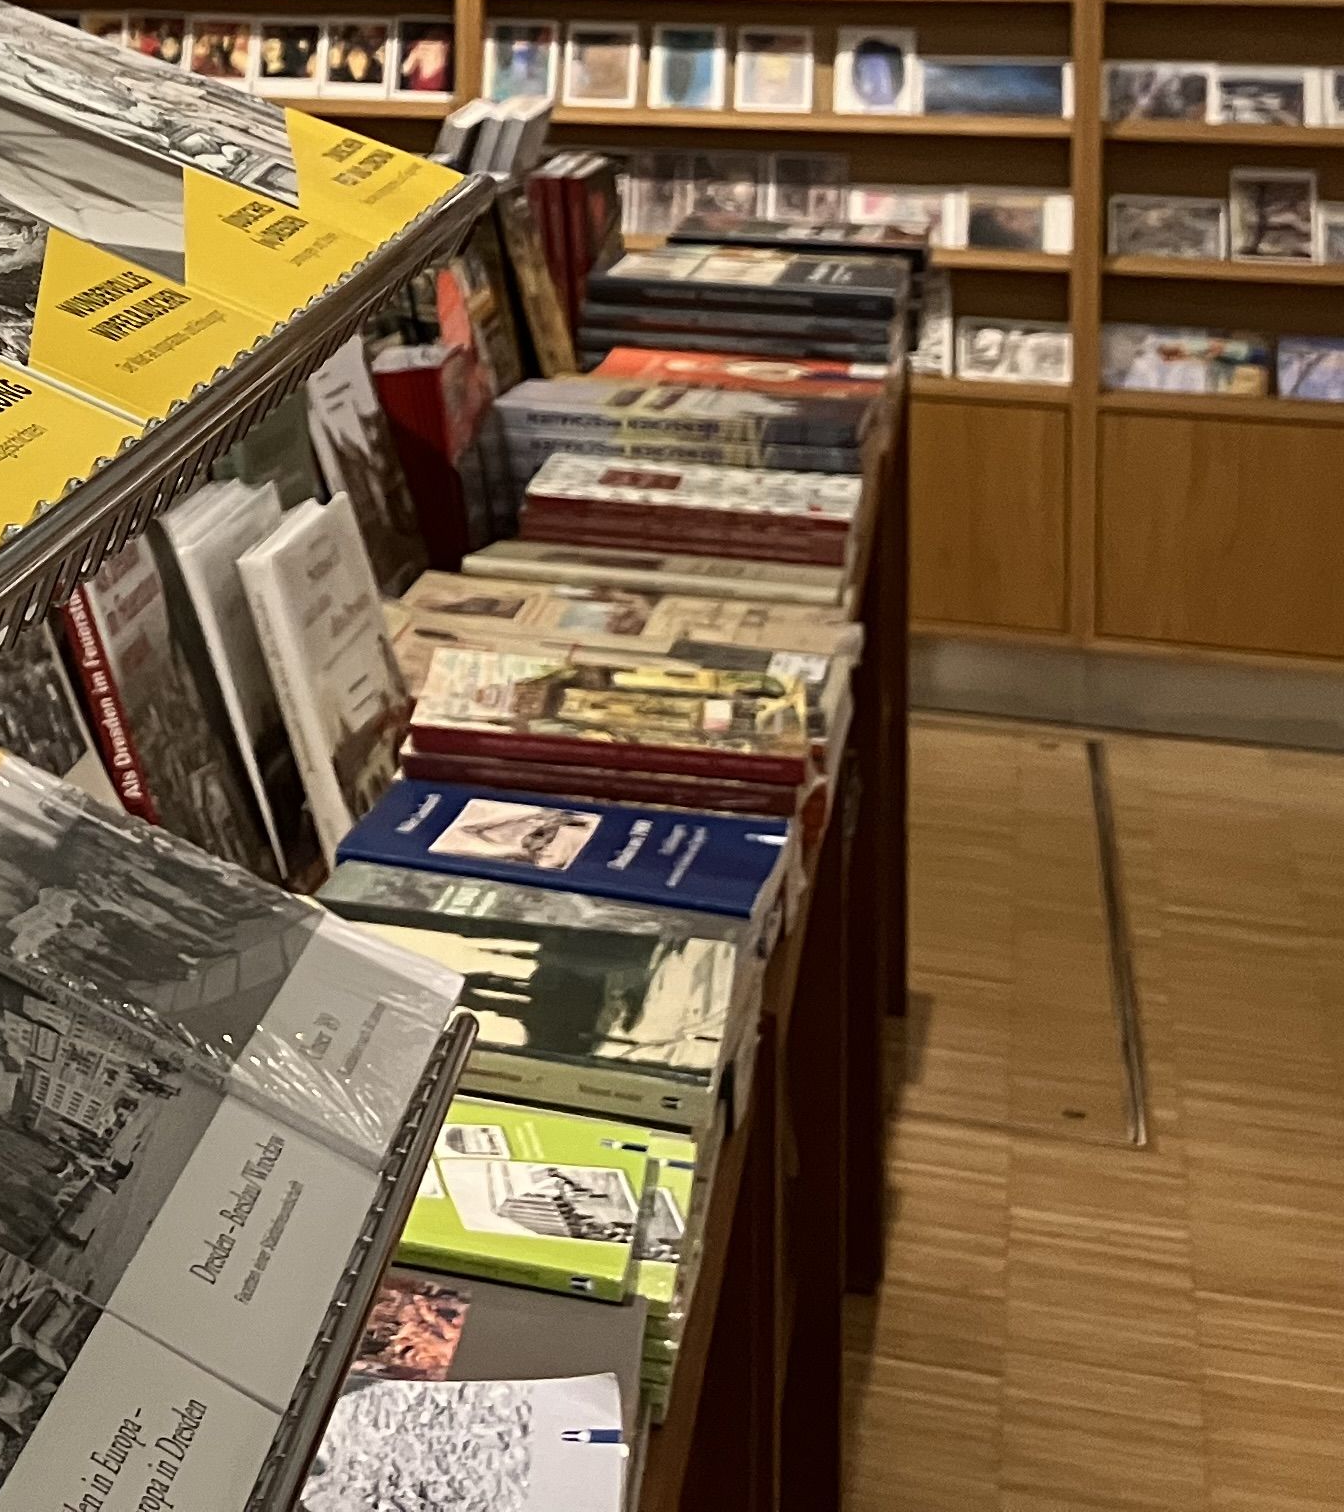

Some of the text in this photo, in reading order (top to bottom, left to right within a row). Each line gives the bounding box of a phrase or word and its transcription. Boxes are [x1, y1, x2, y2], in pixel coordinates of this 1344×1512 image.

[91, 670, 143, 800] Als Dresden im
[189, 1233, 236, 1285] Dresden
[81, 1418, 146, 1495] in Europa
[148, 1399, 207, 1481] in Dresden
